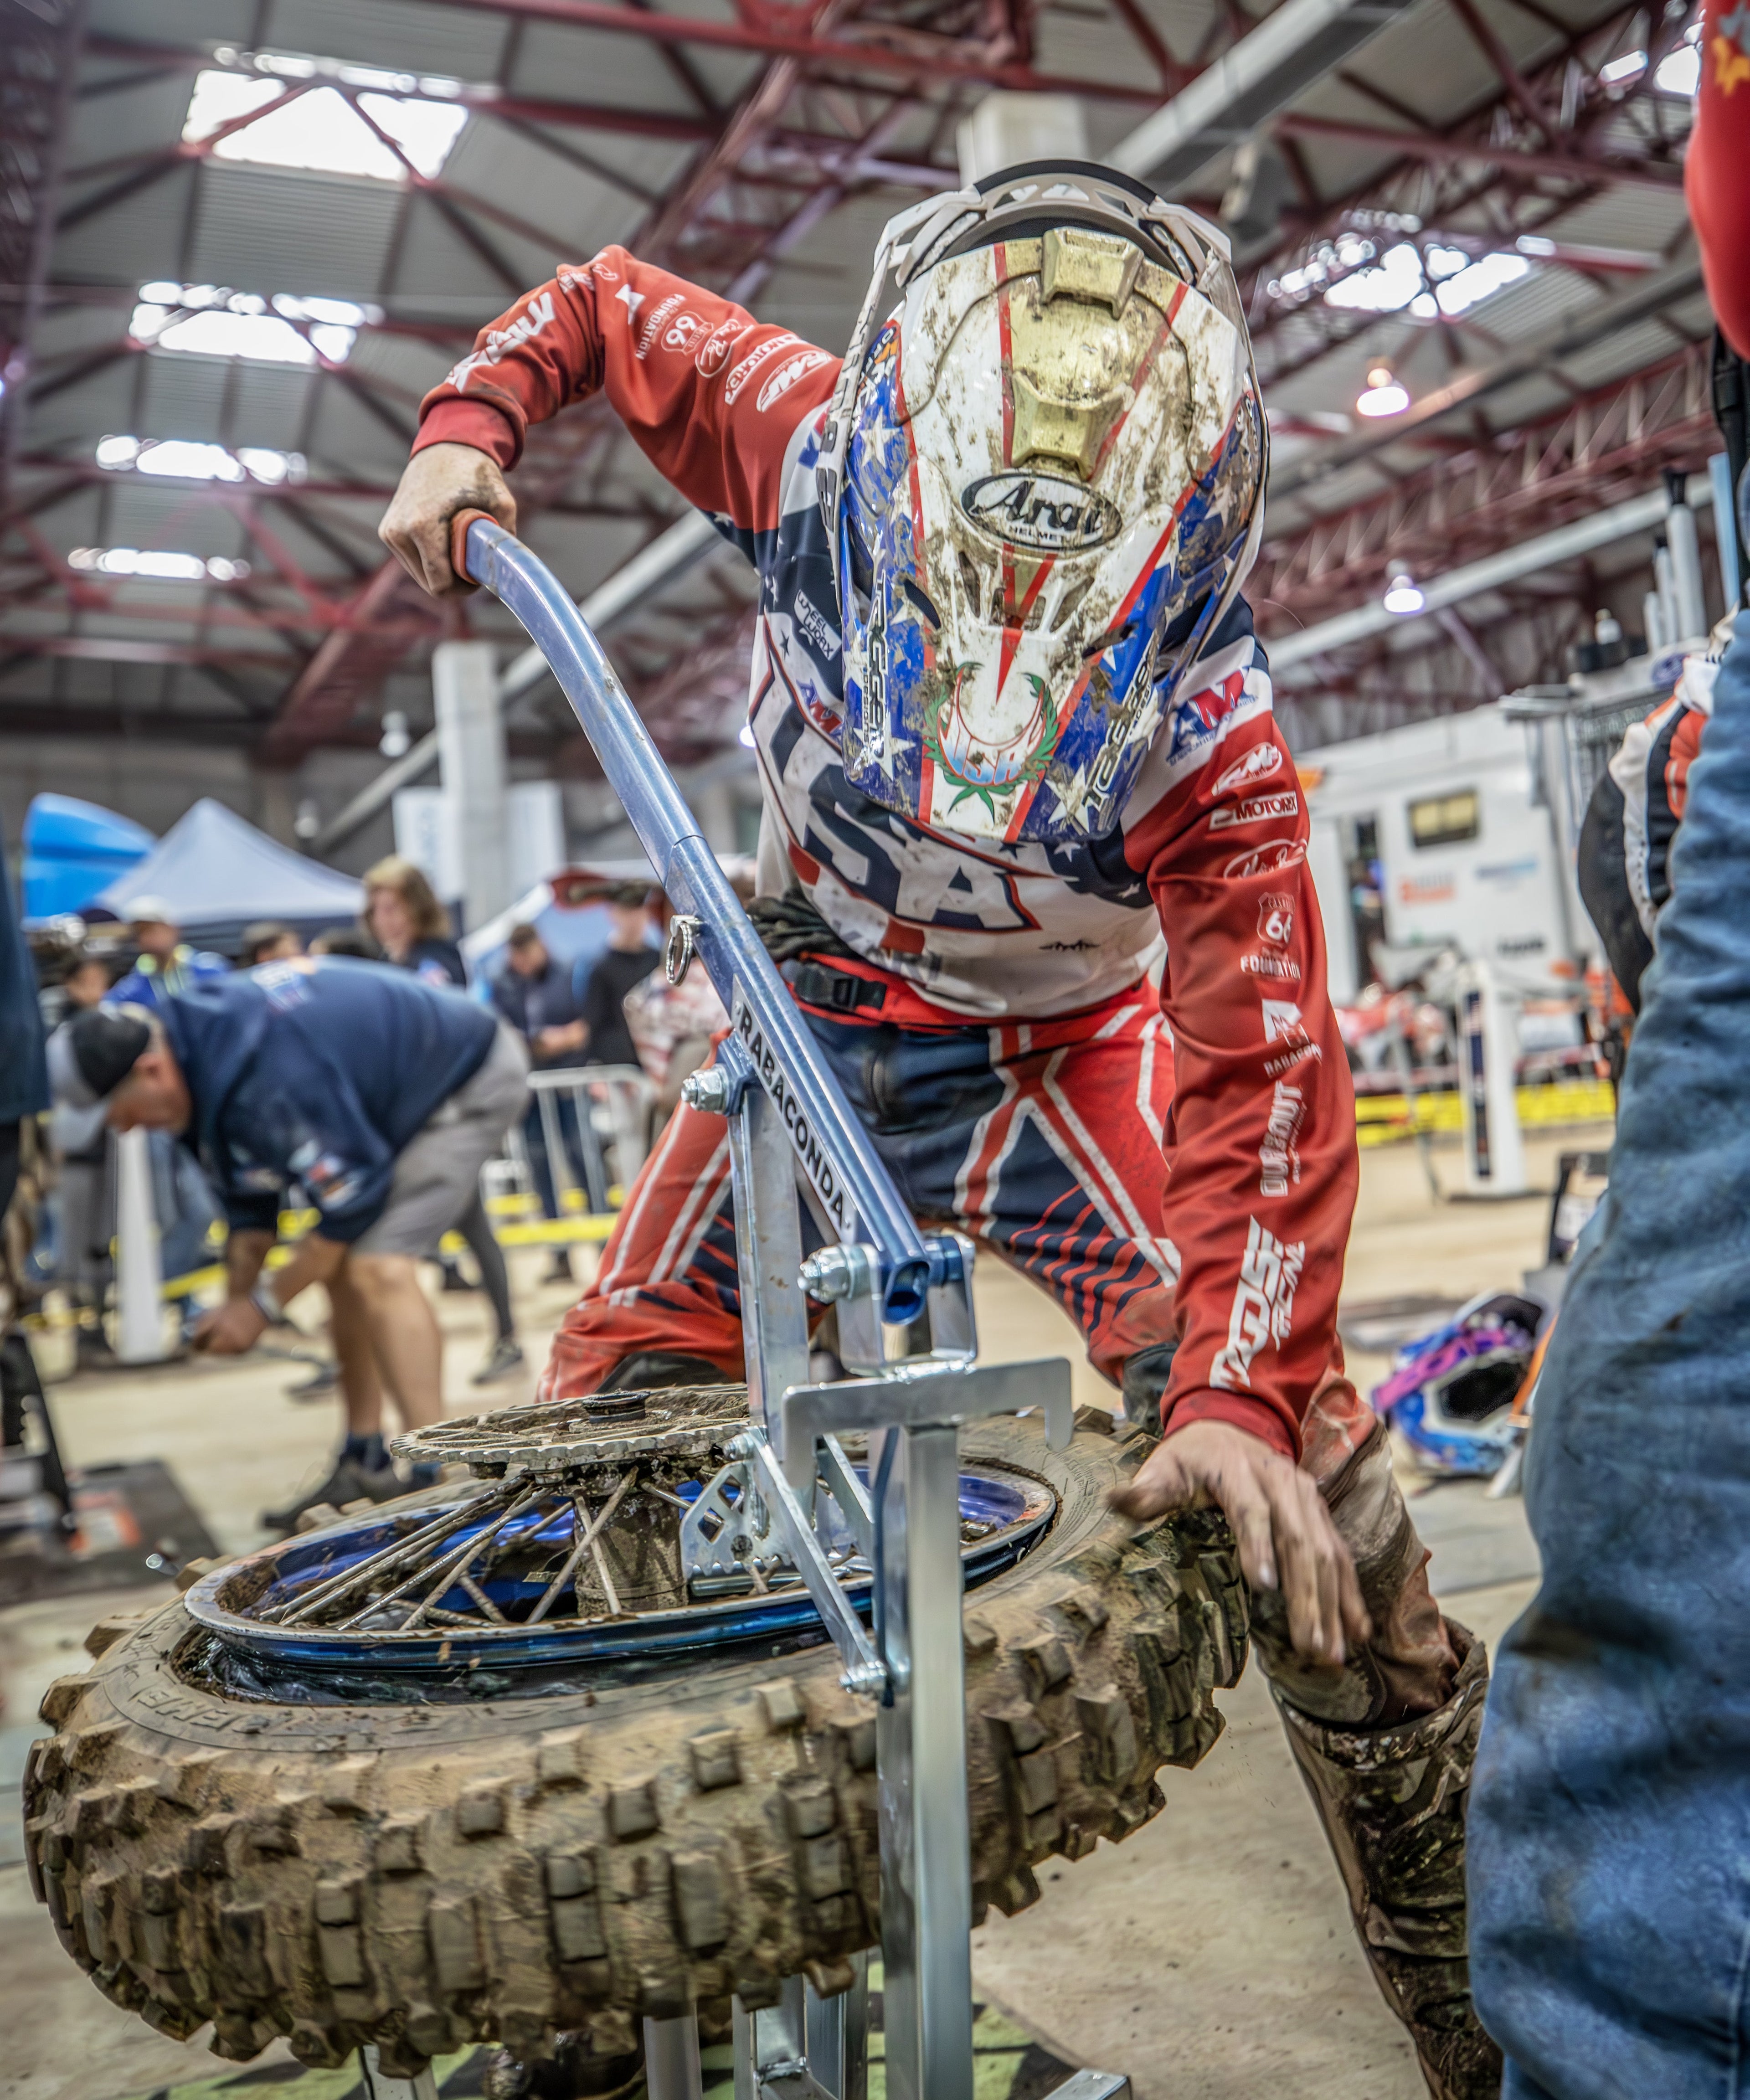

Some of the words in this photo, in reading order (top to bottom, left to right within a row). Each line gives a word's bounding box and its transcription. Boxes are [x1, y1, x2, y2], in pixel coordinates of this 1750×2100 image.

[635, 293, 685, 360] FOUNDATION
[666, 315, 697, 346] 66
[762, 352, 830, 409] FMF
[937, 667, 1047, 786] USA
[1236, 793, 1297, 820] MOTOREX
[739, 1004, 844, 1226] RABACONDA
